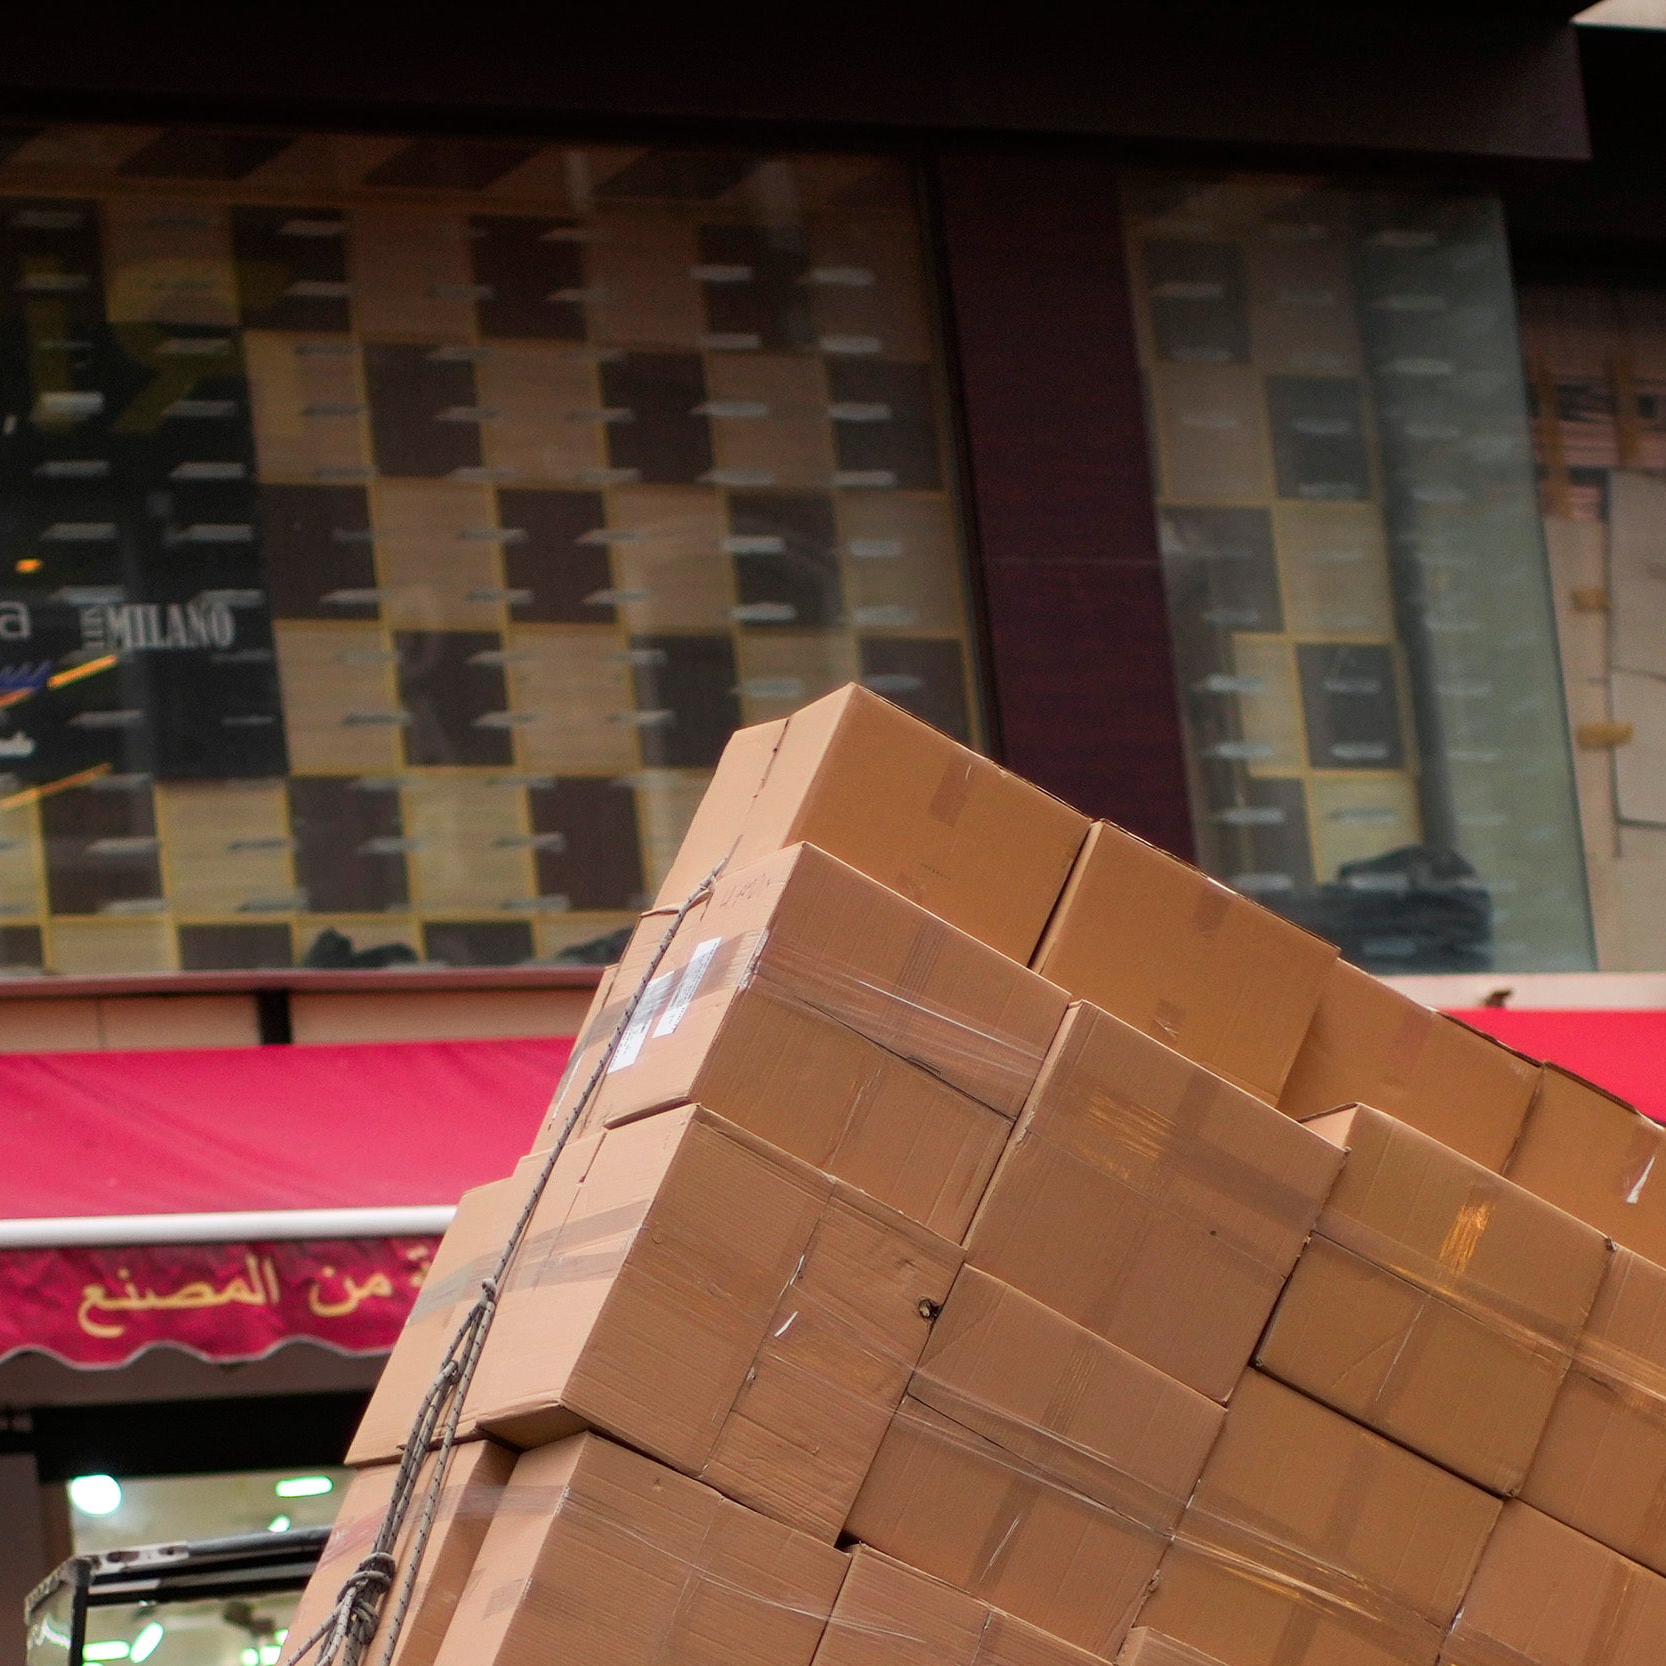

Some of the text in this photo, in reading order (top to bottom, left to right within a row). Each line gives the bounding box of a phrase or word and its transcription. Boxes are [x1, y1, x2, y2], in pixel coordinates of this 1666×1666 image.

[106, 602, 236, 650] MILANO
[77, 1253, 280, 1339] المصنع
[308, 1264, 394, 1318] من
